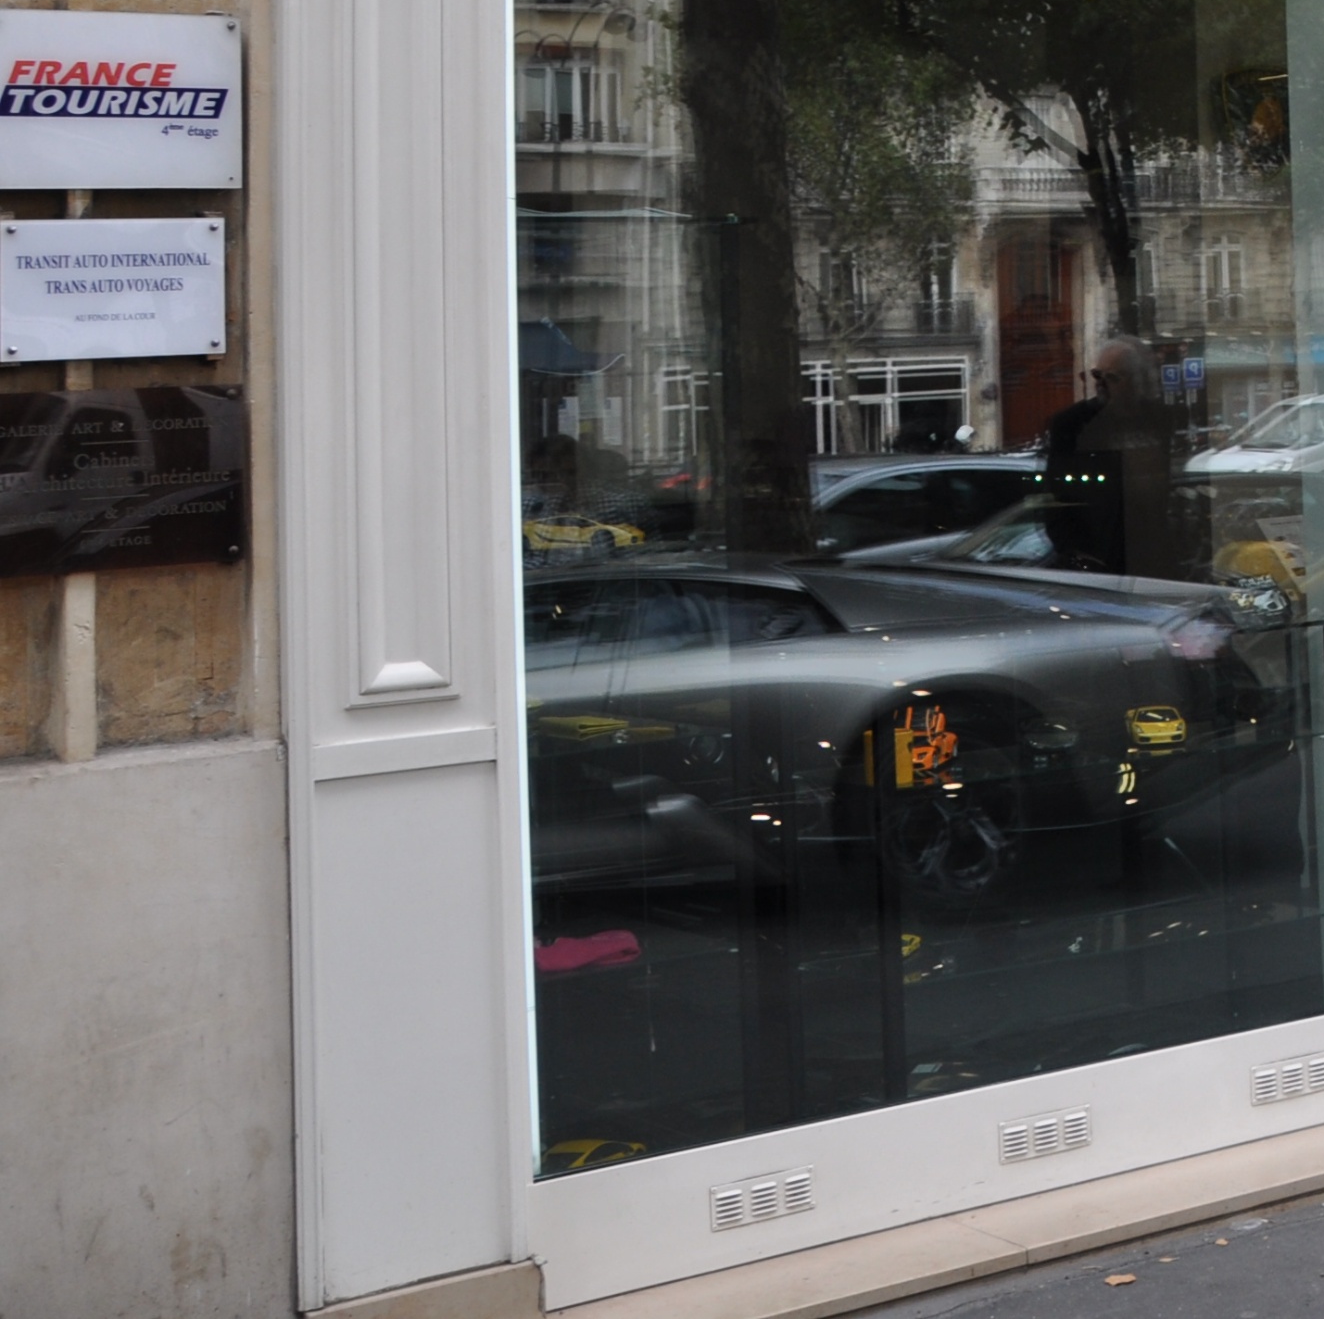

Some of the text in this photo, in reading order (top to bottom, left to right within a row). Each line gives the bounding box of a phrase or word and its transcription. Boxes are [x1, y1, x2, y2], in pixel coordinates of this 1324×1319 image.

[8, 60, 177, 88] FRANCE
[8, 88, 221, 117] TOURISME
[187, 124, 219, 140] étage
[16, 252, 211, 270] TRANSIT AUTO INTERNATIONAL
[45, 277, 184, 295] TRANS AUTO VOYAGES
[87, 313, 110, 322] FOND
[111, 313, 121, 321] DE
[123, 313, 133, 321] LA
[134, 312, 156, 321] COUR
[71, 421, 104, 435] ART
[142, 466, 230, 487] Intérieure
